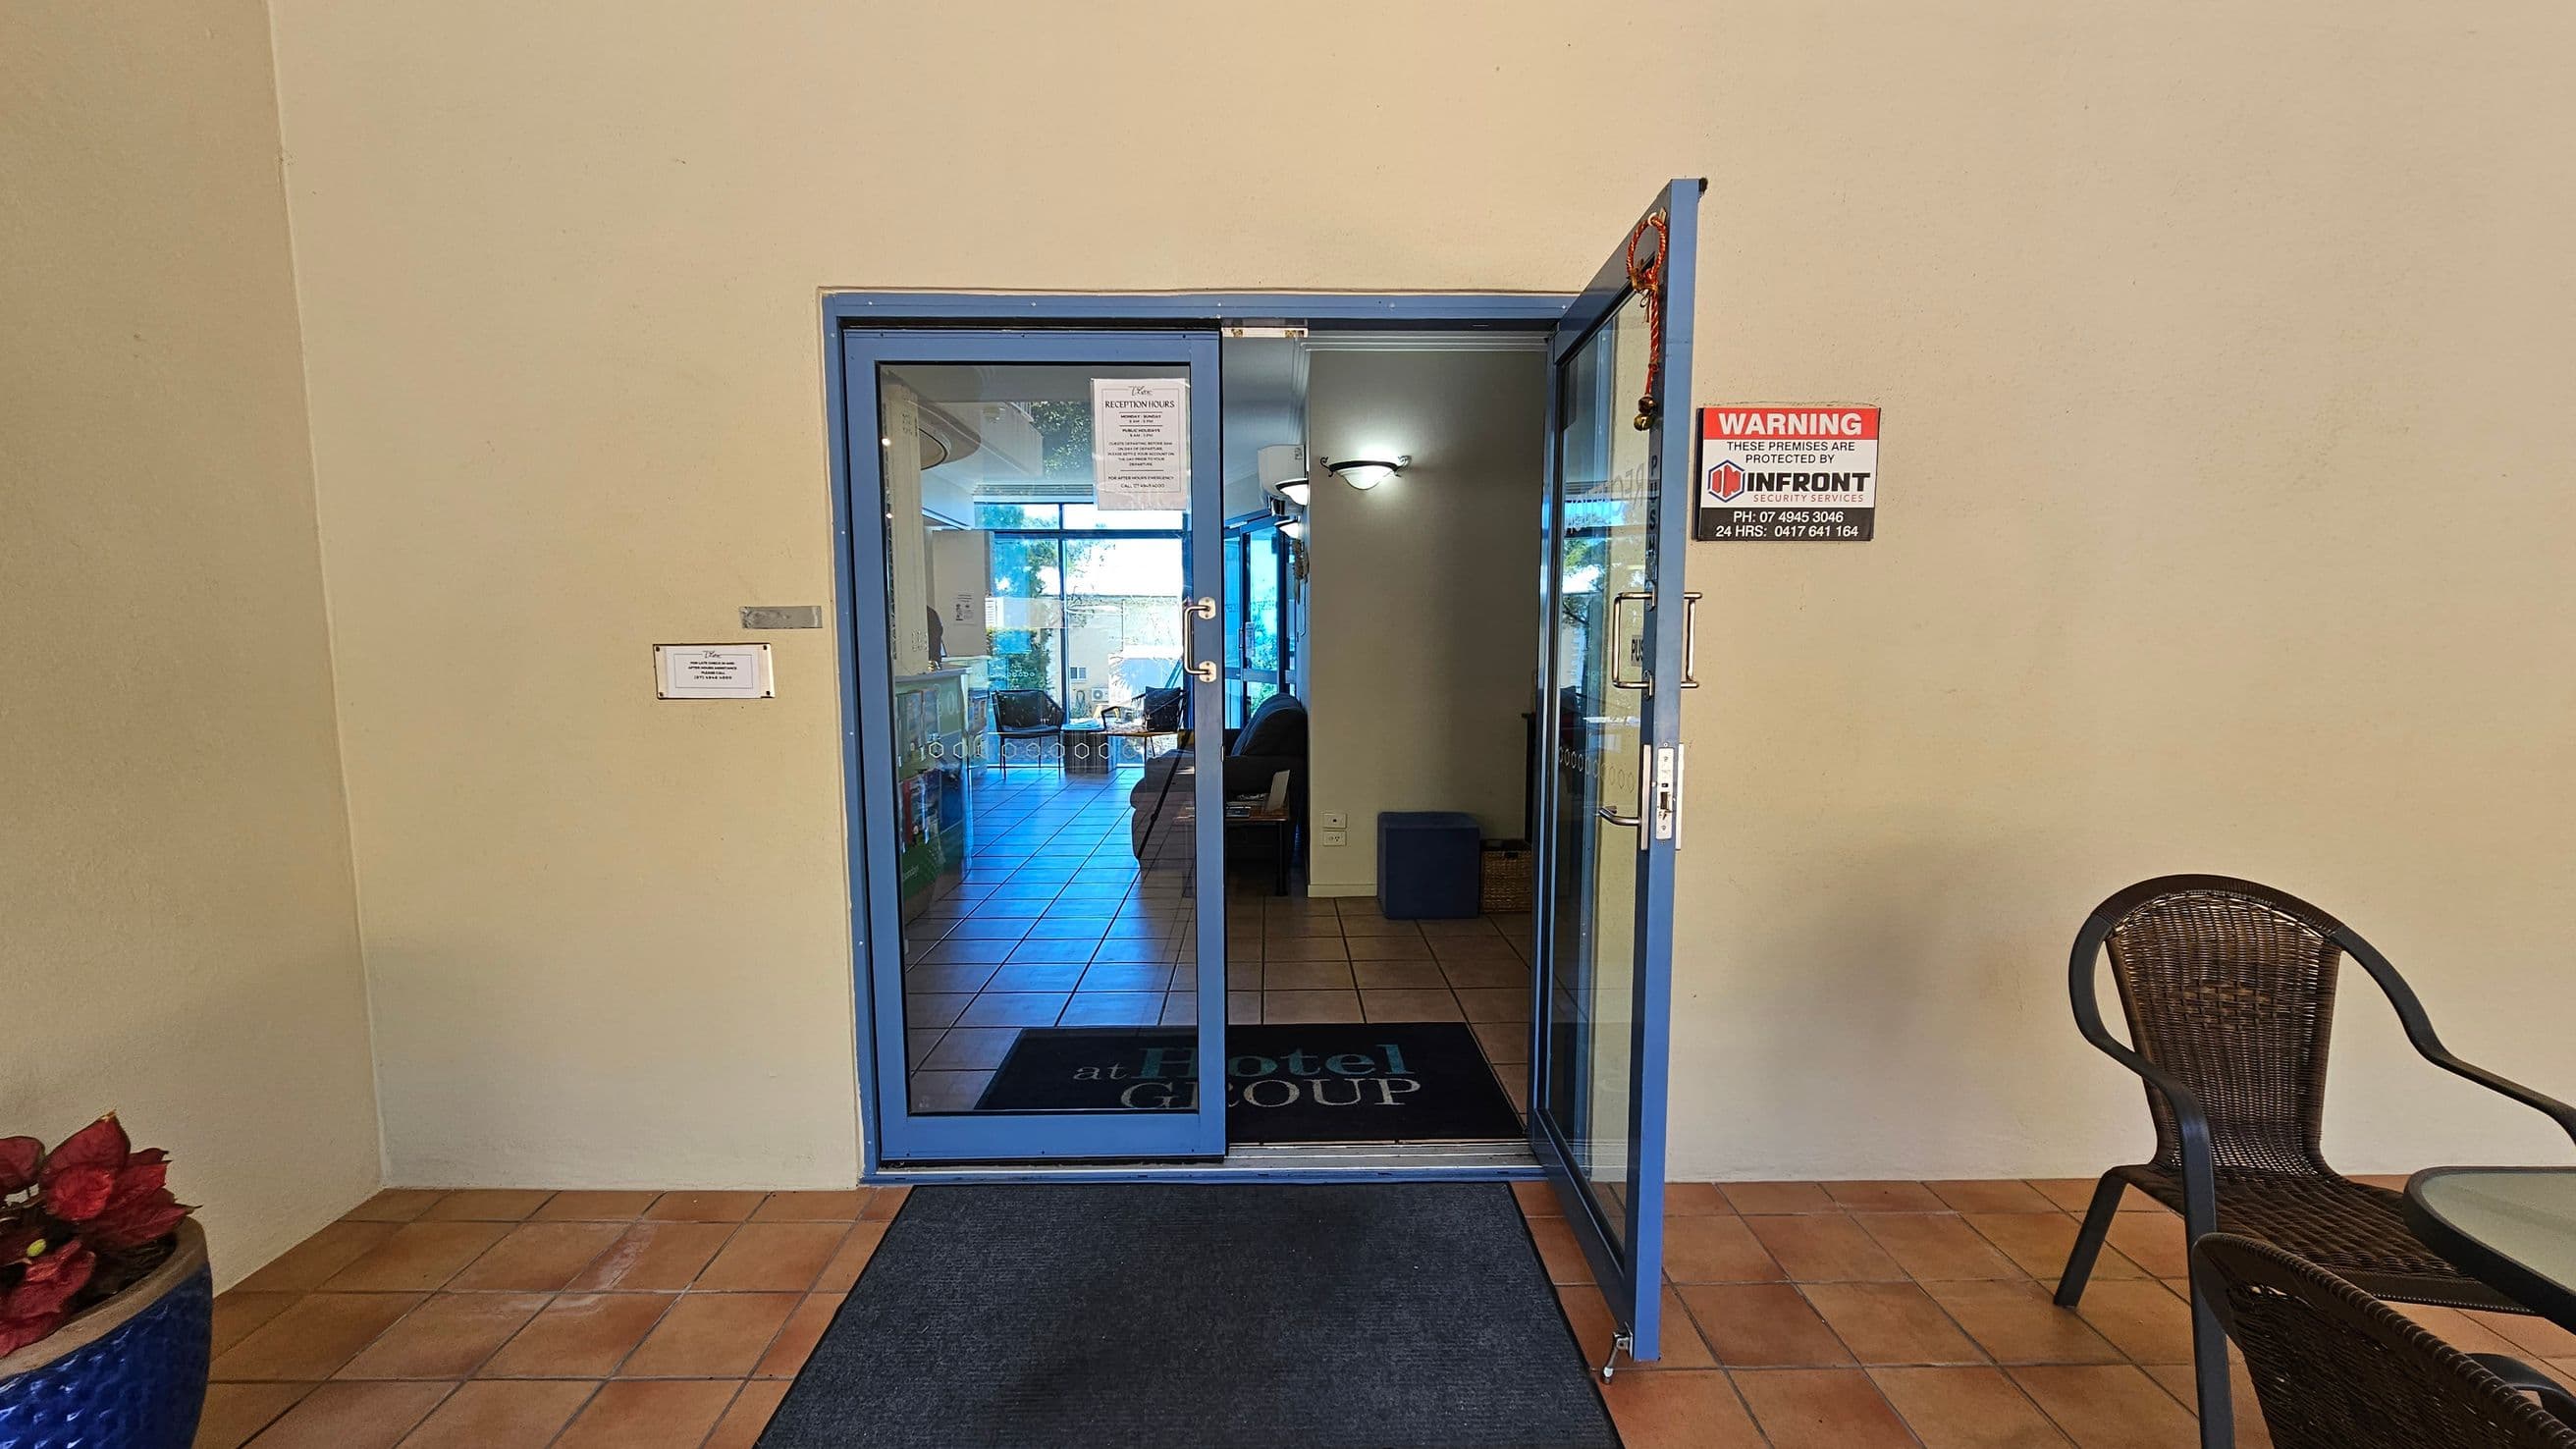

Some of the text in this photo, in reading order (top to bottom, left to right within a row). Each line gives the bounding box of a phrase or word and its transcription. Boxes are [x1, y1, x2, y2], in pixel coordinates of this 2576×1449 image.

[1719, 413, 1862, 435] WARNING
[1727, 442, 1854, 451] THESE PREMISES ARE
[1745, 455, 1835, 463] PROTECTED BY
[1747, 473, 1870, 492] INFRONT
[1734, 511, 1844, 522] PH: 07 4945 3046
[1716, 526, 1858, 537] 24 HRS: 0417 641 164
[1073, 1045, 1416, 1081] at Hotel
[1120, 1078, 1422, 1110] GOUP
